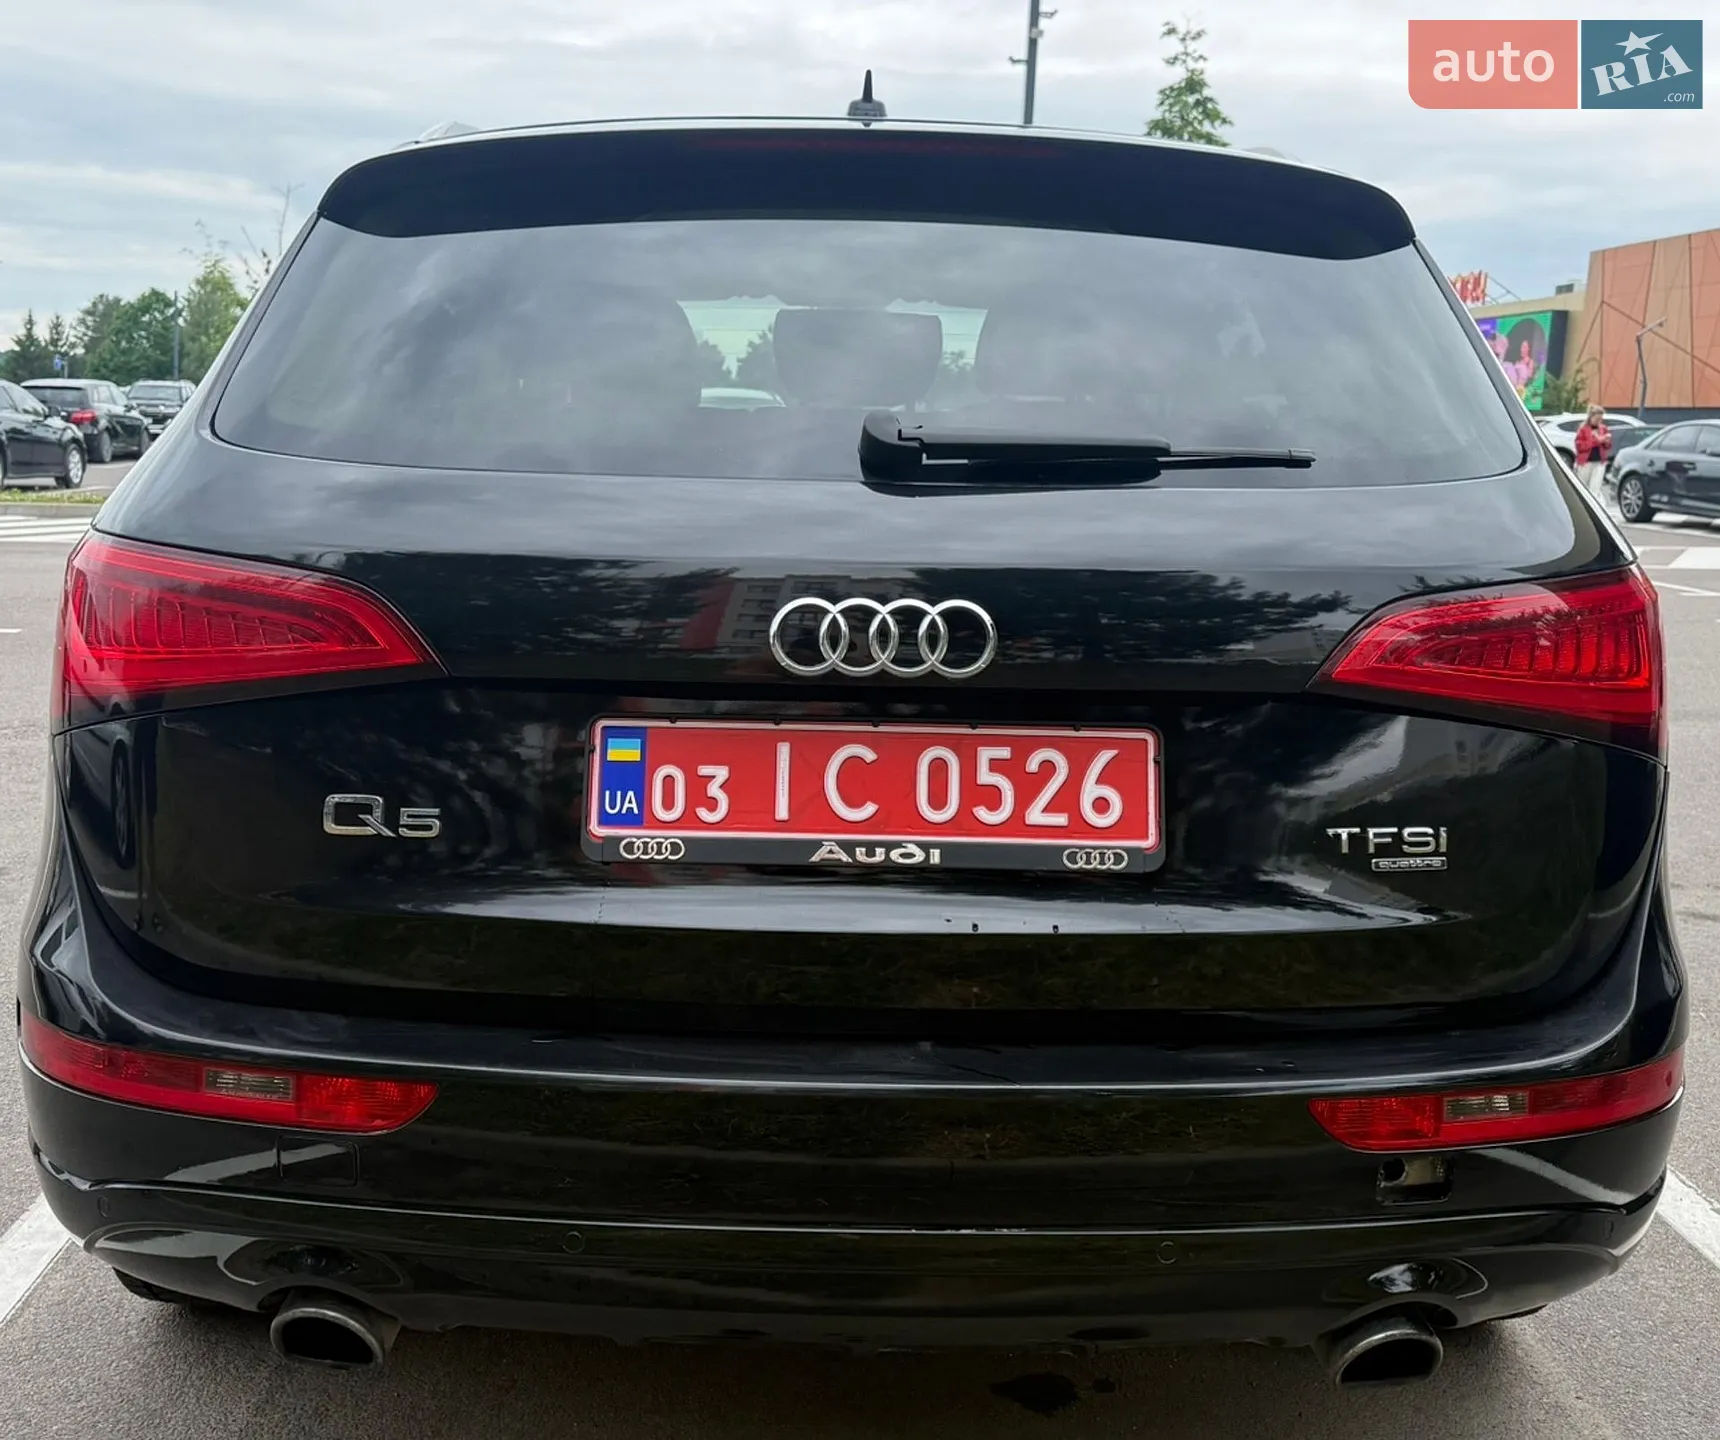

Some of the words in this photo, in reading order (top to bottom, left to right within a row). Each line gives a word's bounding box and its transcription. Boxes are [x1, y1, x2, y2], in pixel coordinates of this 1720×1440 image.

[651, 764, 730, 824] 03
[914, 744, 1124, 829] 0526
[323, 793, 441, 838] Q5
[604, 790, 639, 815] UA
[808, 841, 942, 867] Audi
[1378, 858, 1443, 870] quattro
